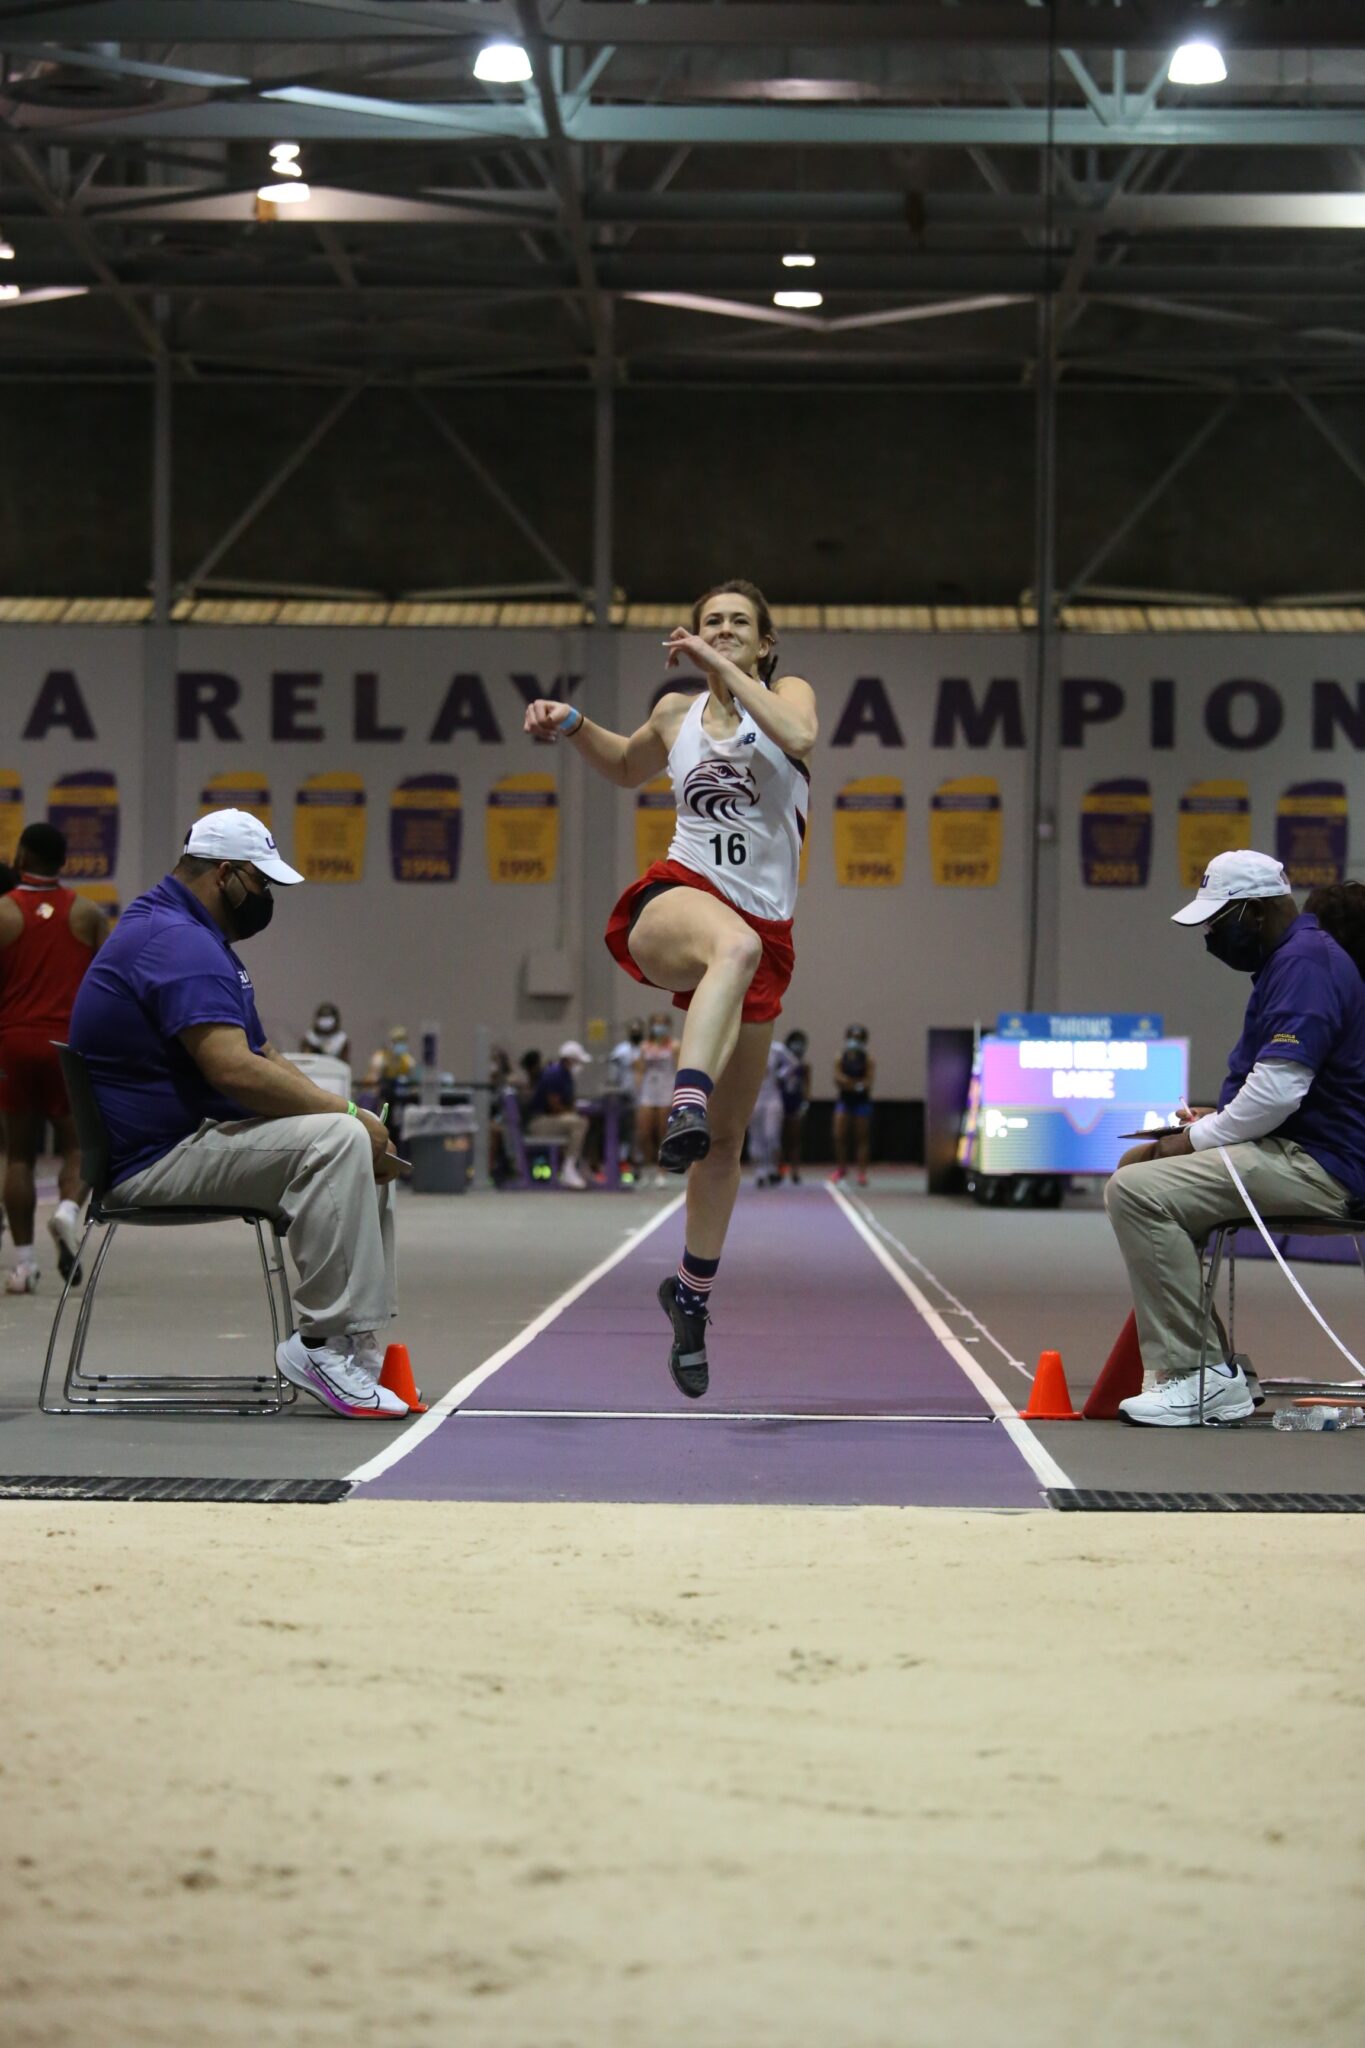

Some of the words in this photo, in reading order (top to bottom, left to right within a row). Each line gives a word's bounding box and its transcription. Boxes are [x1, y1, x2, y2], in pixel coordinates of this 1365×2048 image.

[22, 670, 98, 740] A
[176, 671, 584, 745] RELAY
[709, 832, 747, 866] 16
[1049, 1016, 1112, 1039] THROWS
